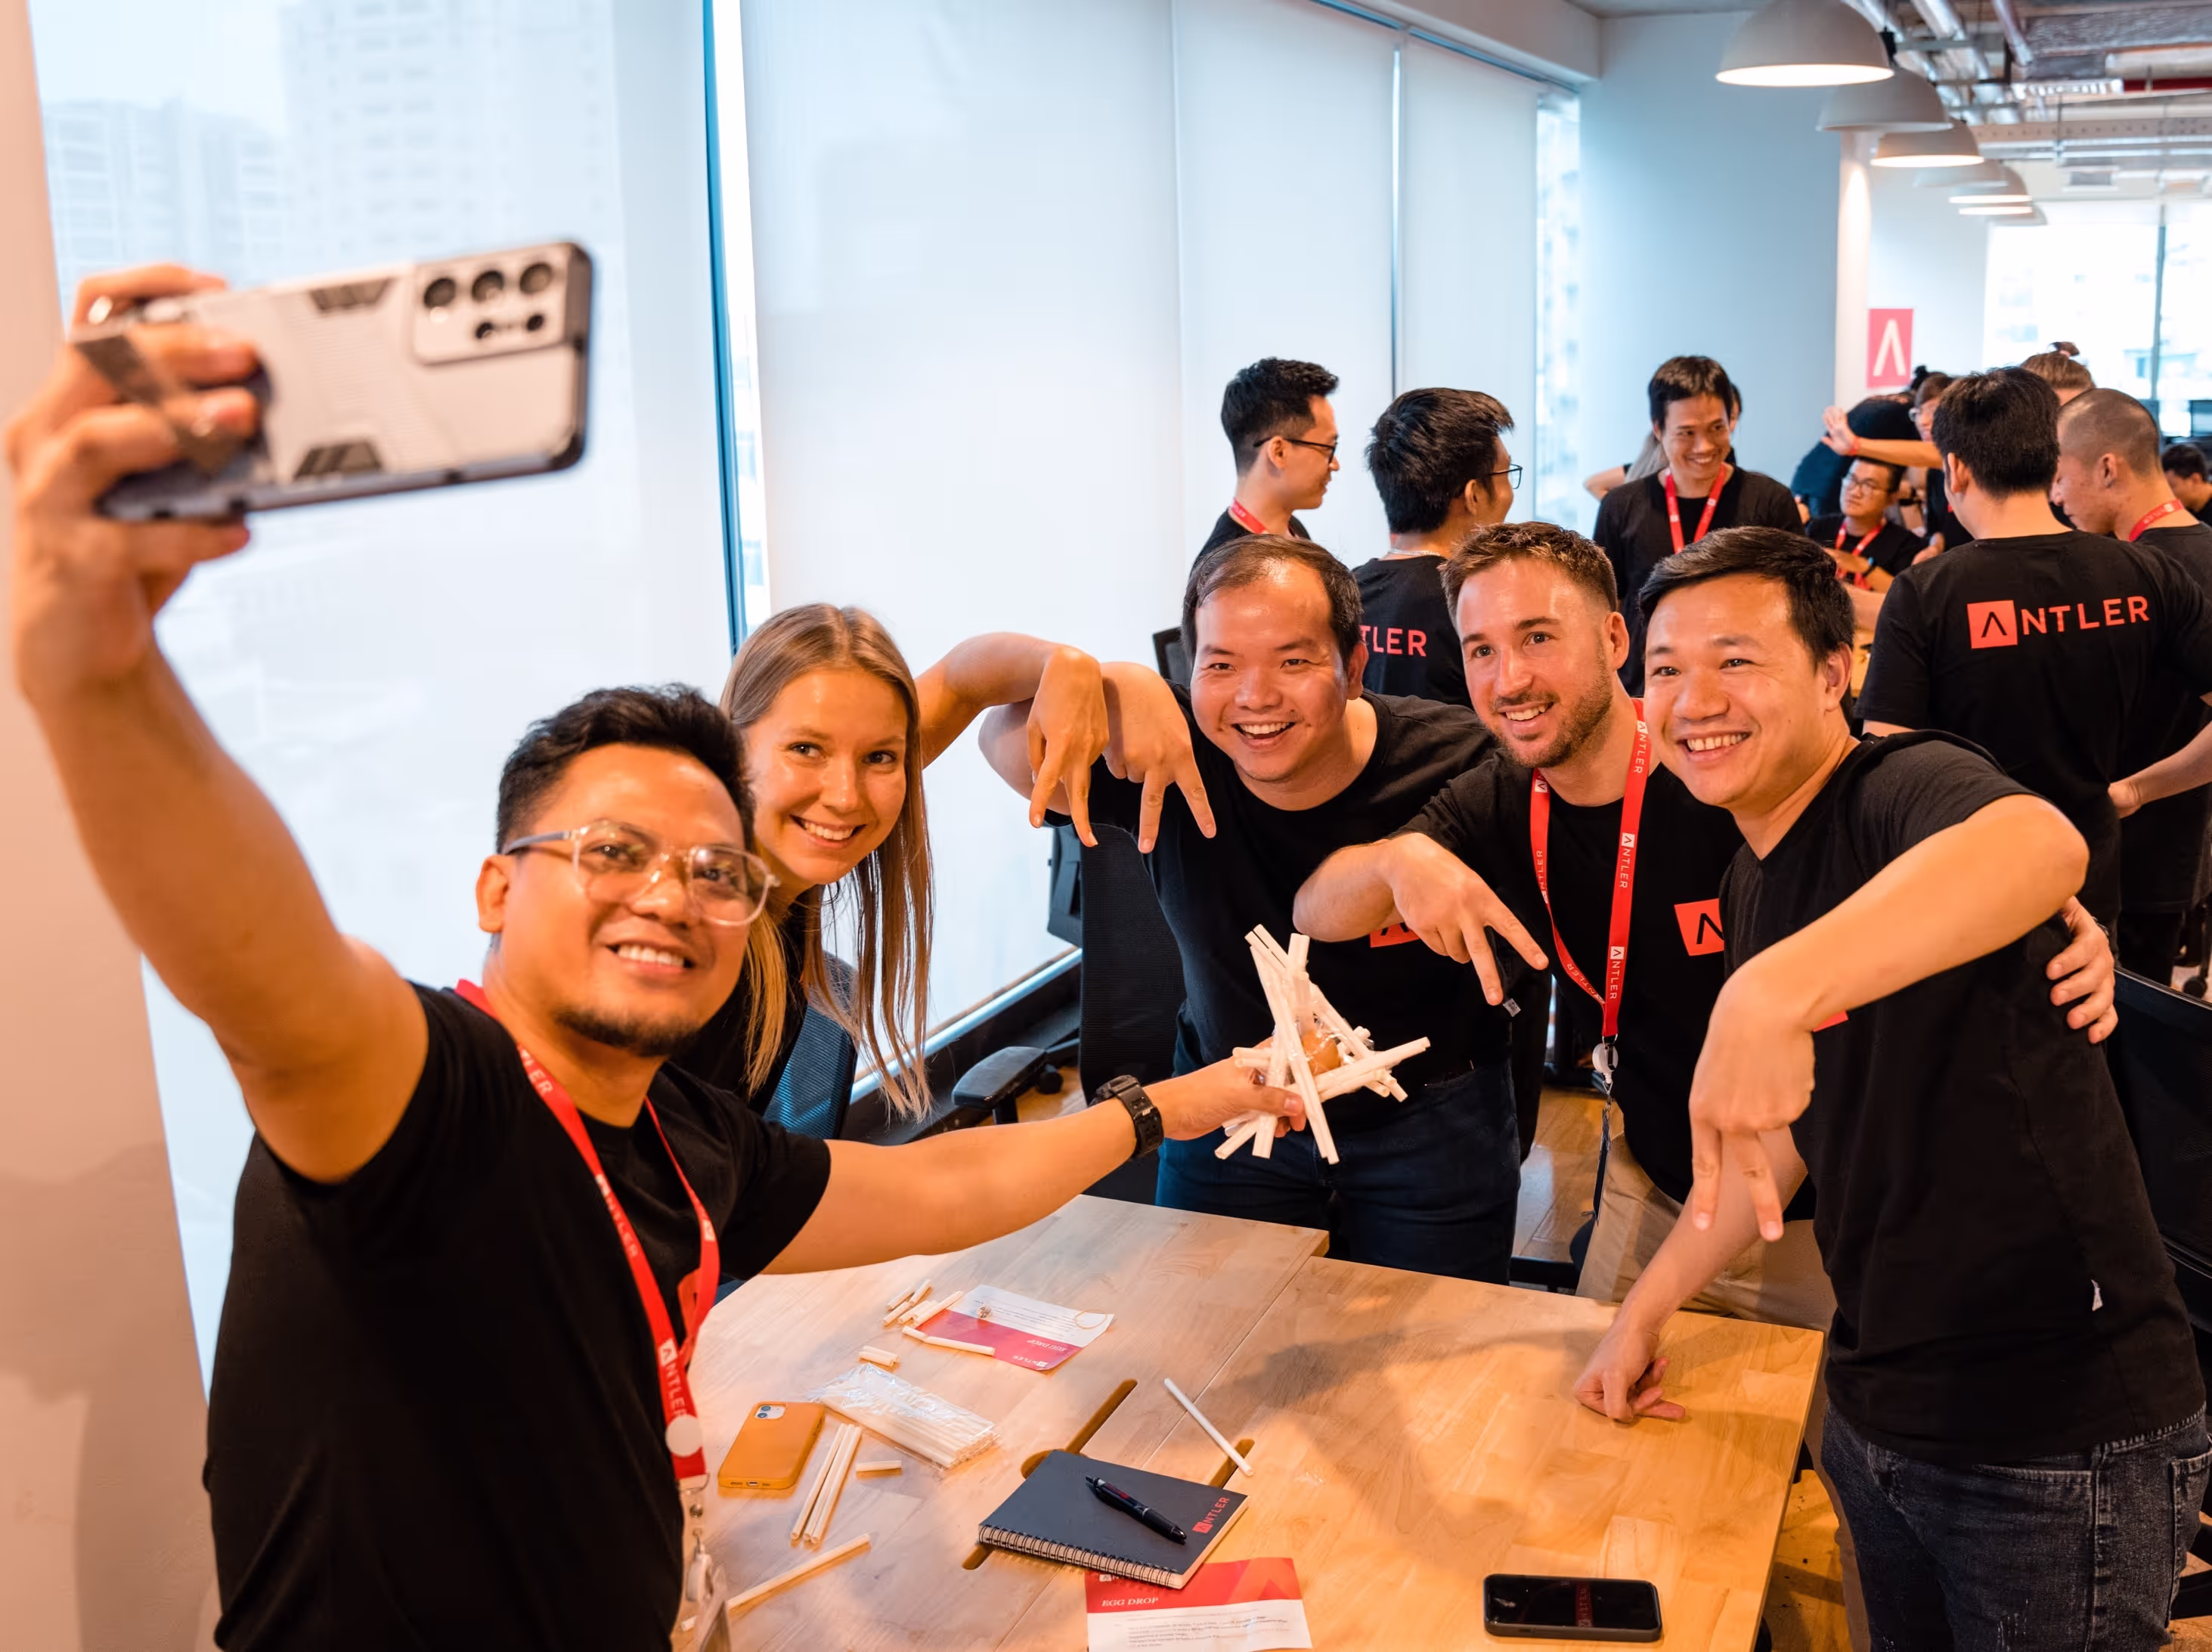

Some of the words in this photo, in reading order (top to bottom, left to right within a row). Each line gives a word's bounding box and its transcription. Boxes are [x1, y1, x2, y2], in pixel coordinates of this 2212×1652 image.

[1358, 625, 1427, 657] TLER
[1967, 595, 2150, 649] ANTLER
[1633, 720, 1649, 774] ANTLER
[1619, 832, 1636, 888] ANTLER
[1609, 946, 1625, 1000] ANTLER
[1192, 1497, 1231, 1534] ANTLER
[1127, 1597, 1158, 1606] DROP
